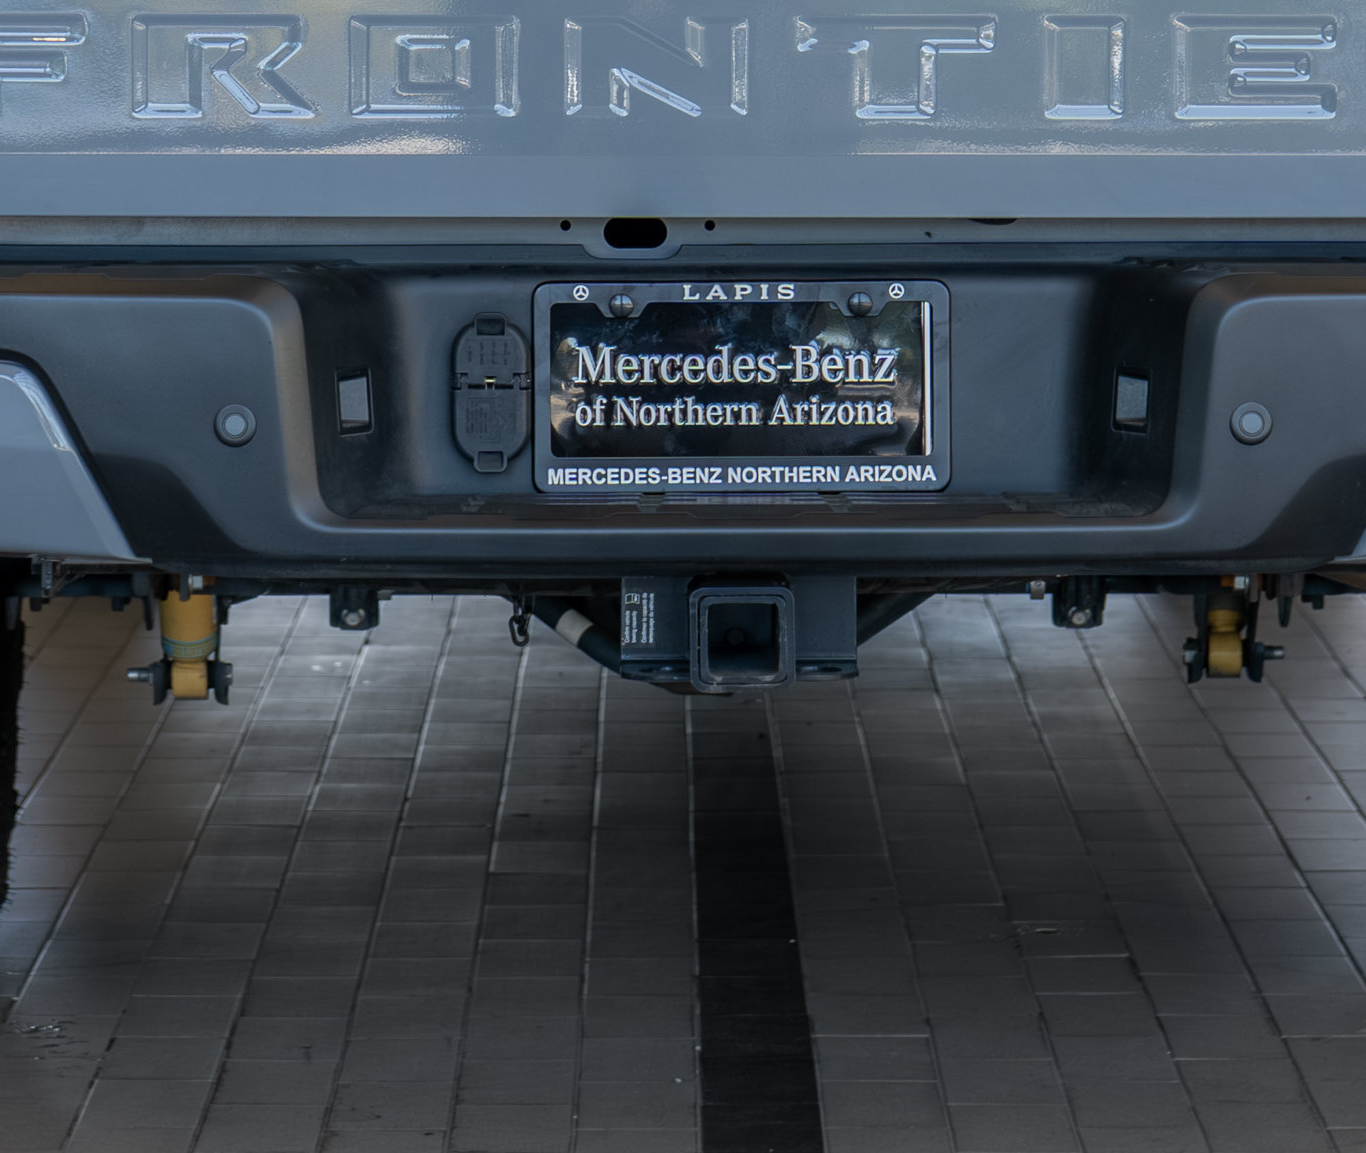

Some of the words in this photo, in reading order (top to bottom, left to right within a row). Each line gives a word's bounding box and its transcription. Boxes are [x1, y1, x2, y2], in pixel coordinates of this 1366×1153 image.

[682, 283, 796, 301] LAPIS
[573, 343, 900, 384] Mercedes-Benz
[574, 395, 607, 427] of
[611, 395, 761, 427] Northern
[767, 395, 896, 426] Arizona
[546, 466, 723, 486] MERCEDES-BENZ
[727, 466, 841, 485] NORTHERN
[844, 464, 937, 484] ARIZONA
